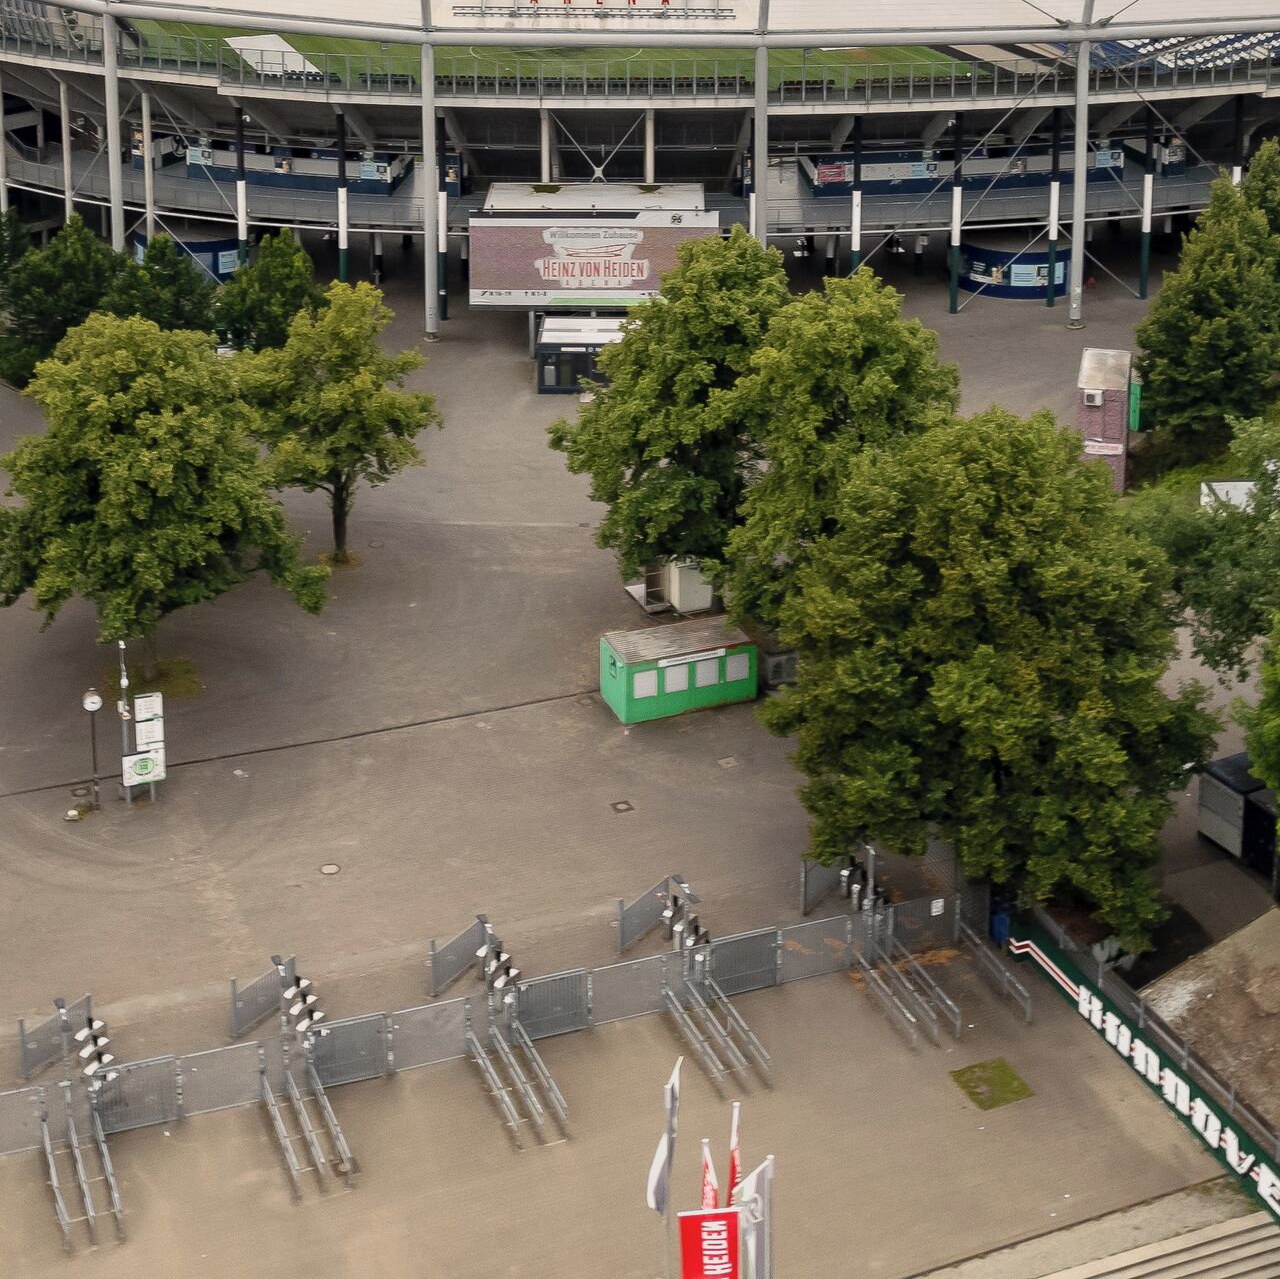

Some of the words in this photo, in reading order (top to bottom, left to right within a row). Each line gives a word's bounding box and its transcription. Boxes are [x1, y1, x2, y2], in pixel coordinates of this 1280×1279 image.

[549, 230, 601, 240] Willkommen
[603, 230, 639, 240] Zuhause
[543, 260, 576, 278] HEINZ
[579, 261, 601, 278] VON
[604, 260, 644, 278] HEIDEN
[701, 1220, 733, 1276] HEIDEN
